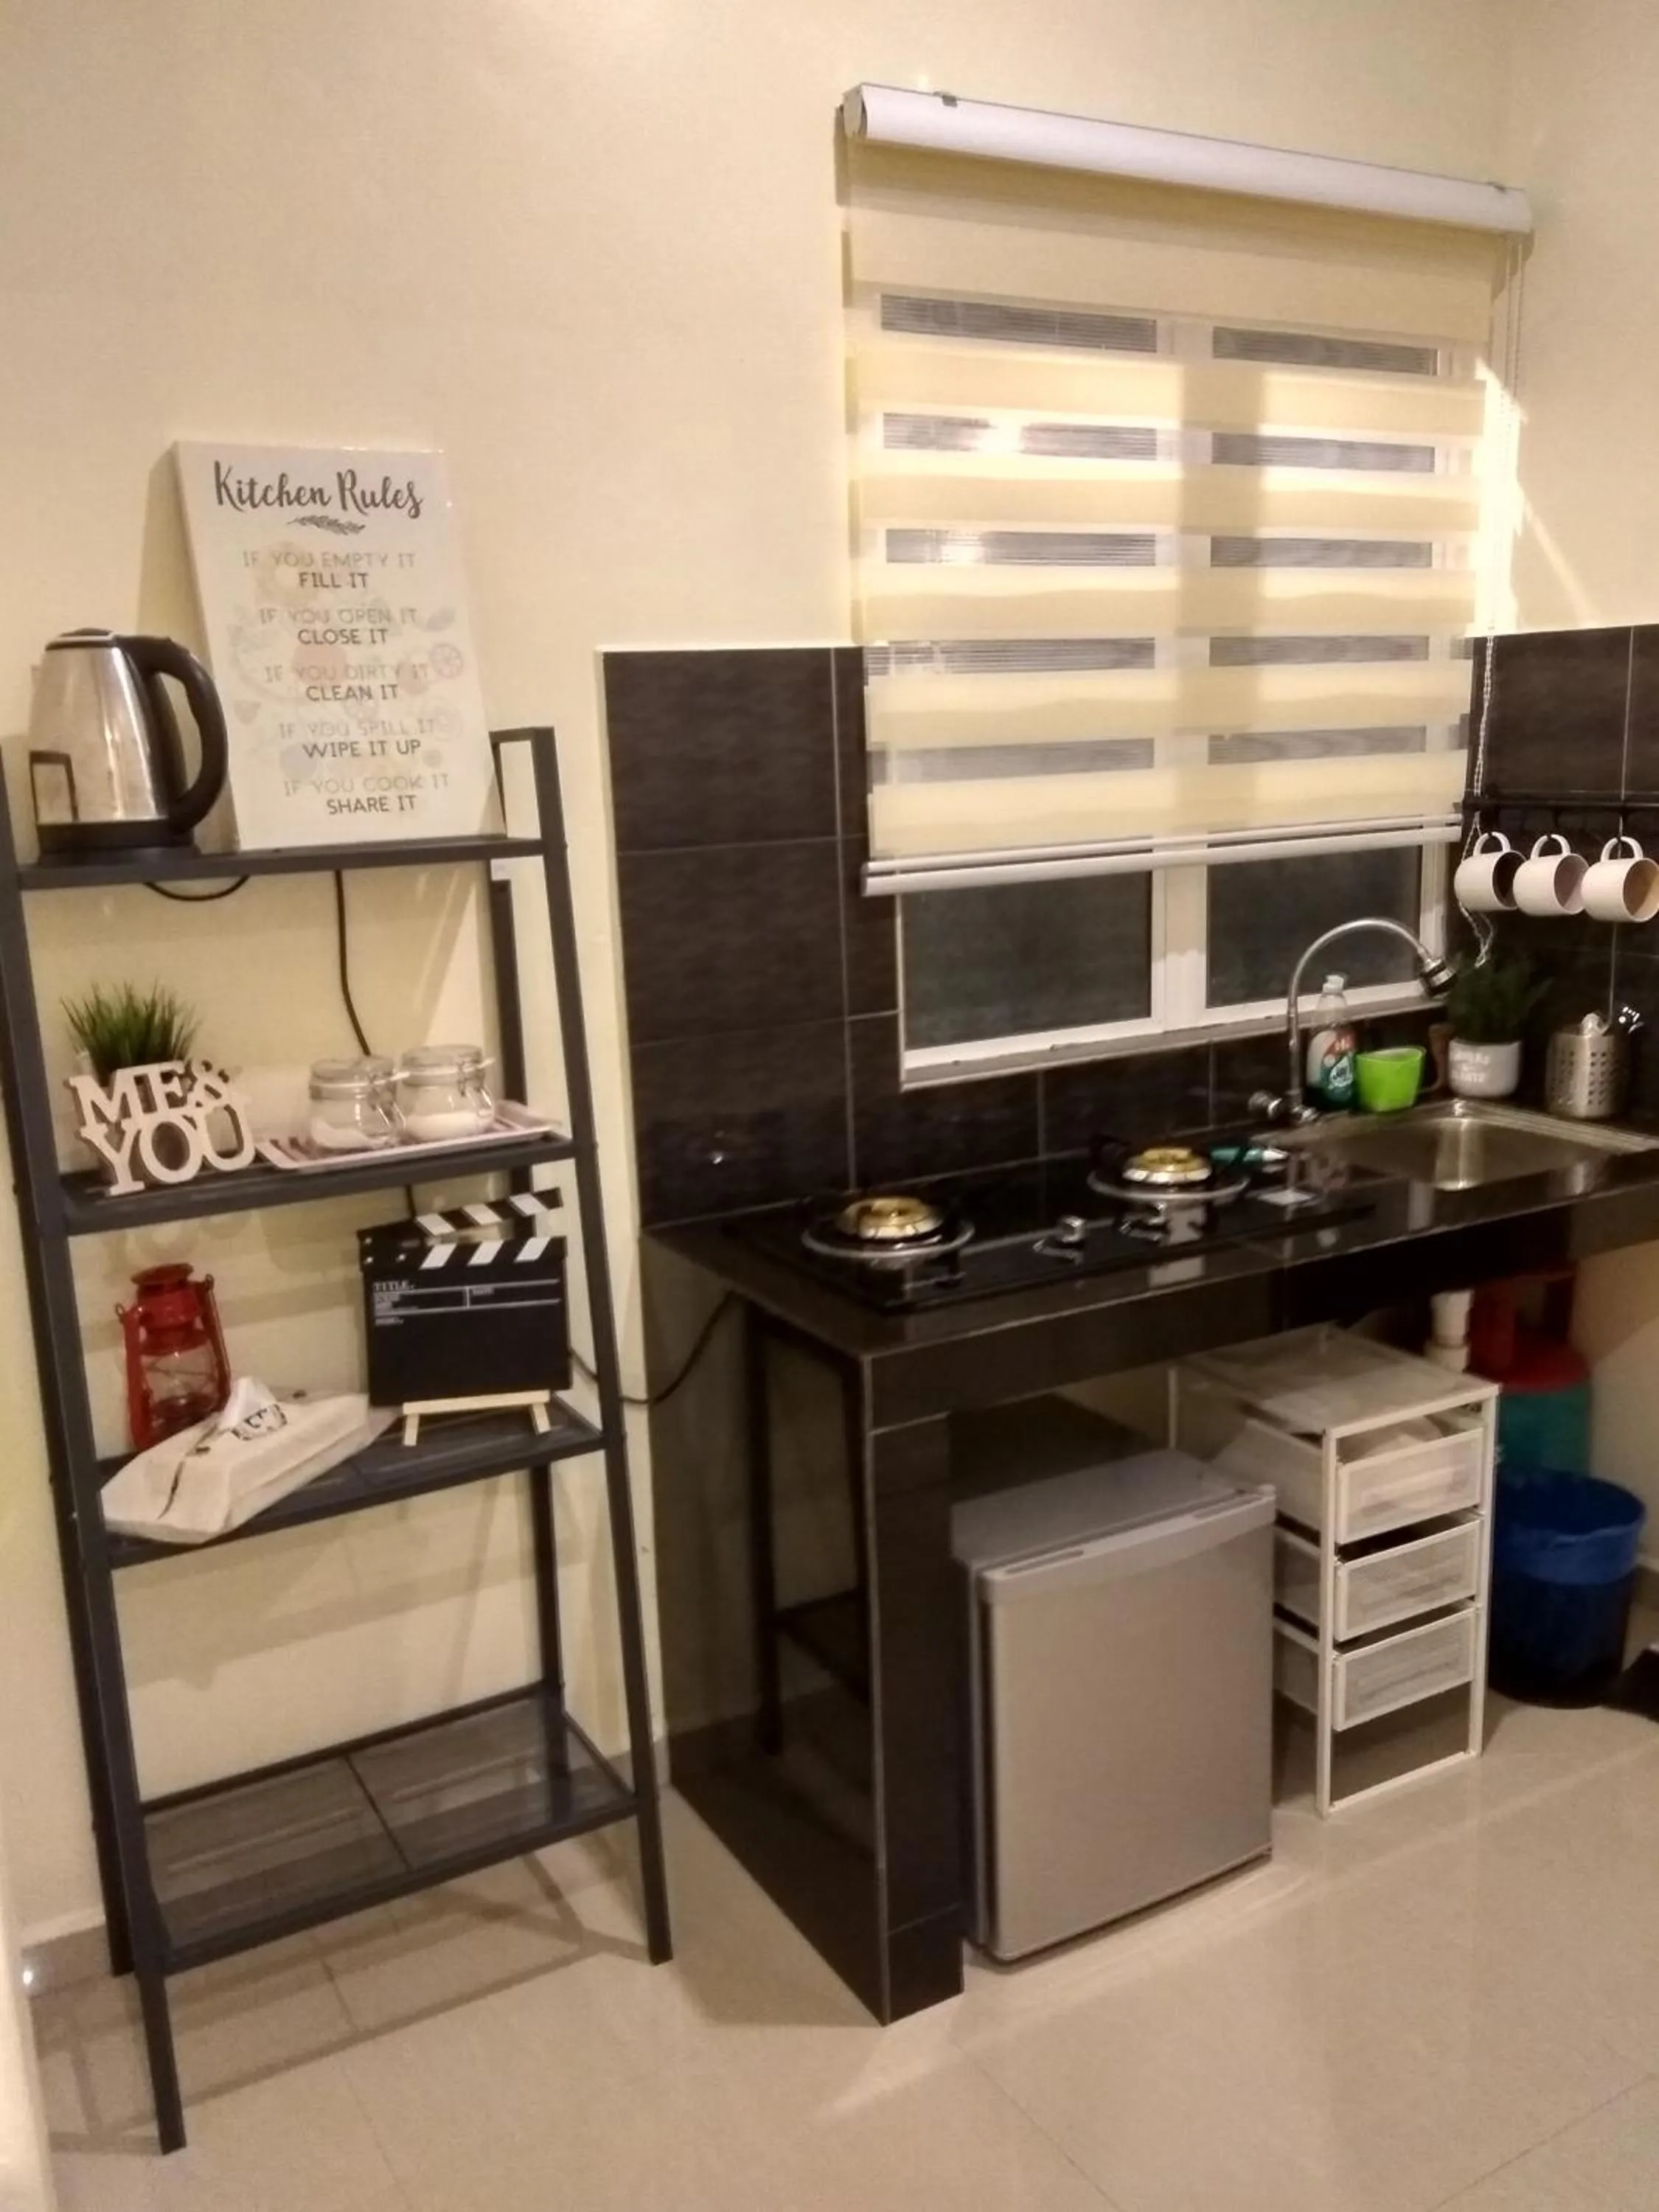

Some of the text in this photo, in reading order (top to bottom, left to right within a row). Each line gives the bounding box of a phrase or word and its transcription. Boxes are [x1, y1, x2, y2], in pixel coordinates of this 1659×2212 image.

[214, 460, 422, 518] Kitchen Rules
[243, 551, 416, 568] IF YOU EMPTY IT
[299, 571, 369, 588] FILL IT
[260, 608, 417, 625] IF YOU OPEN IT
[298, 628, 389, 644] CLOSE IT
[265, 664, 428, 683] IF YOU DIRTY IT
[305, 684, 398, 701] CLEAN IT
[279, 719, 434, 739] IF YOU SPILL IT
[302, 739, 421, 758] WIPE IT UP
[284, 774, 448, 796] IF YOU COOK IT
[327, 795, 417, 815] SHARE IT
[80, 1099, 256, 1196] YOU
